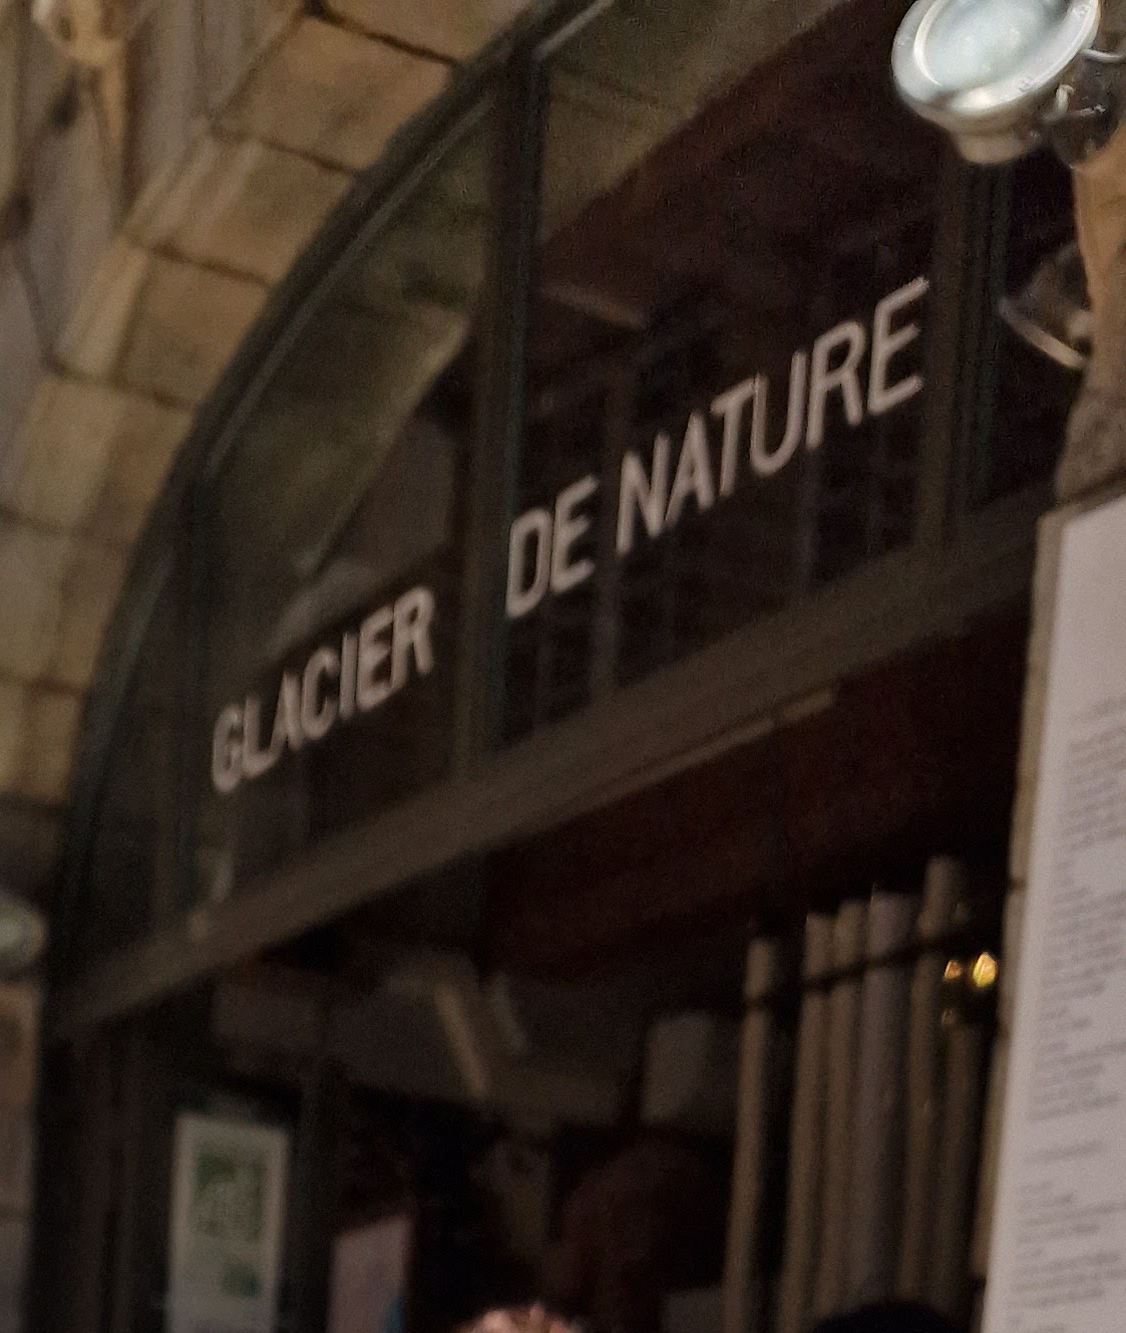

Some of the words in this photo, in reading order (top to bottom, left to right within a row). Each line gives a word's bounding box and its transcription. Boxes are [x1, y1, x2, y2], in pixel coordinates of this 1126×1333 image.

[212, 586, 434, 793] GLACIER
[505, 475, 599, 618] DE
[616, 276, 930, 556] NATURE
